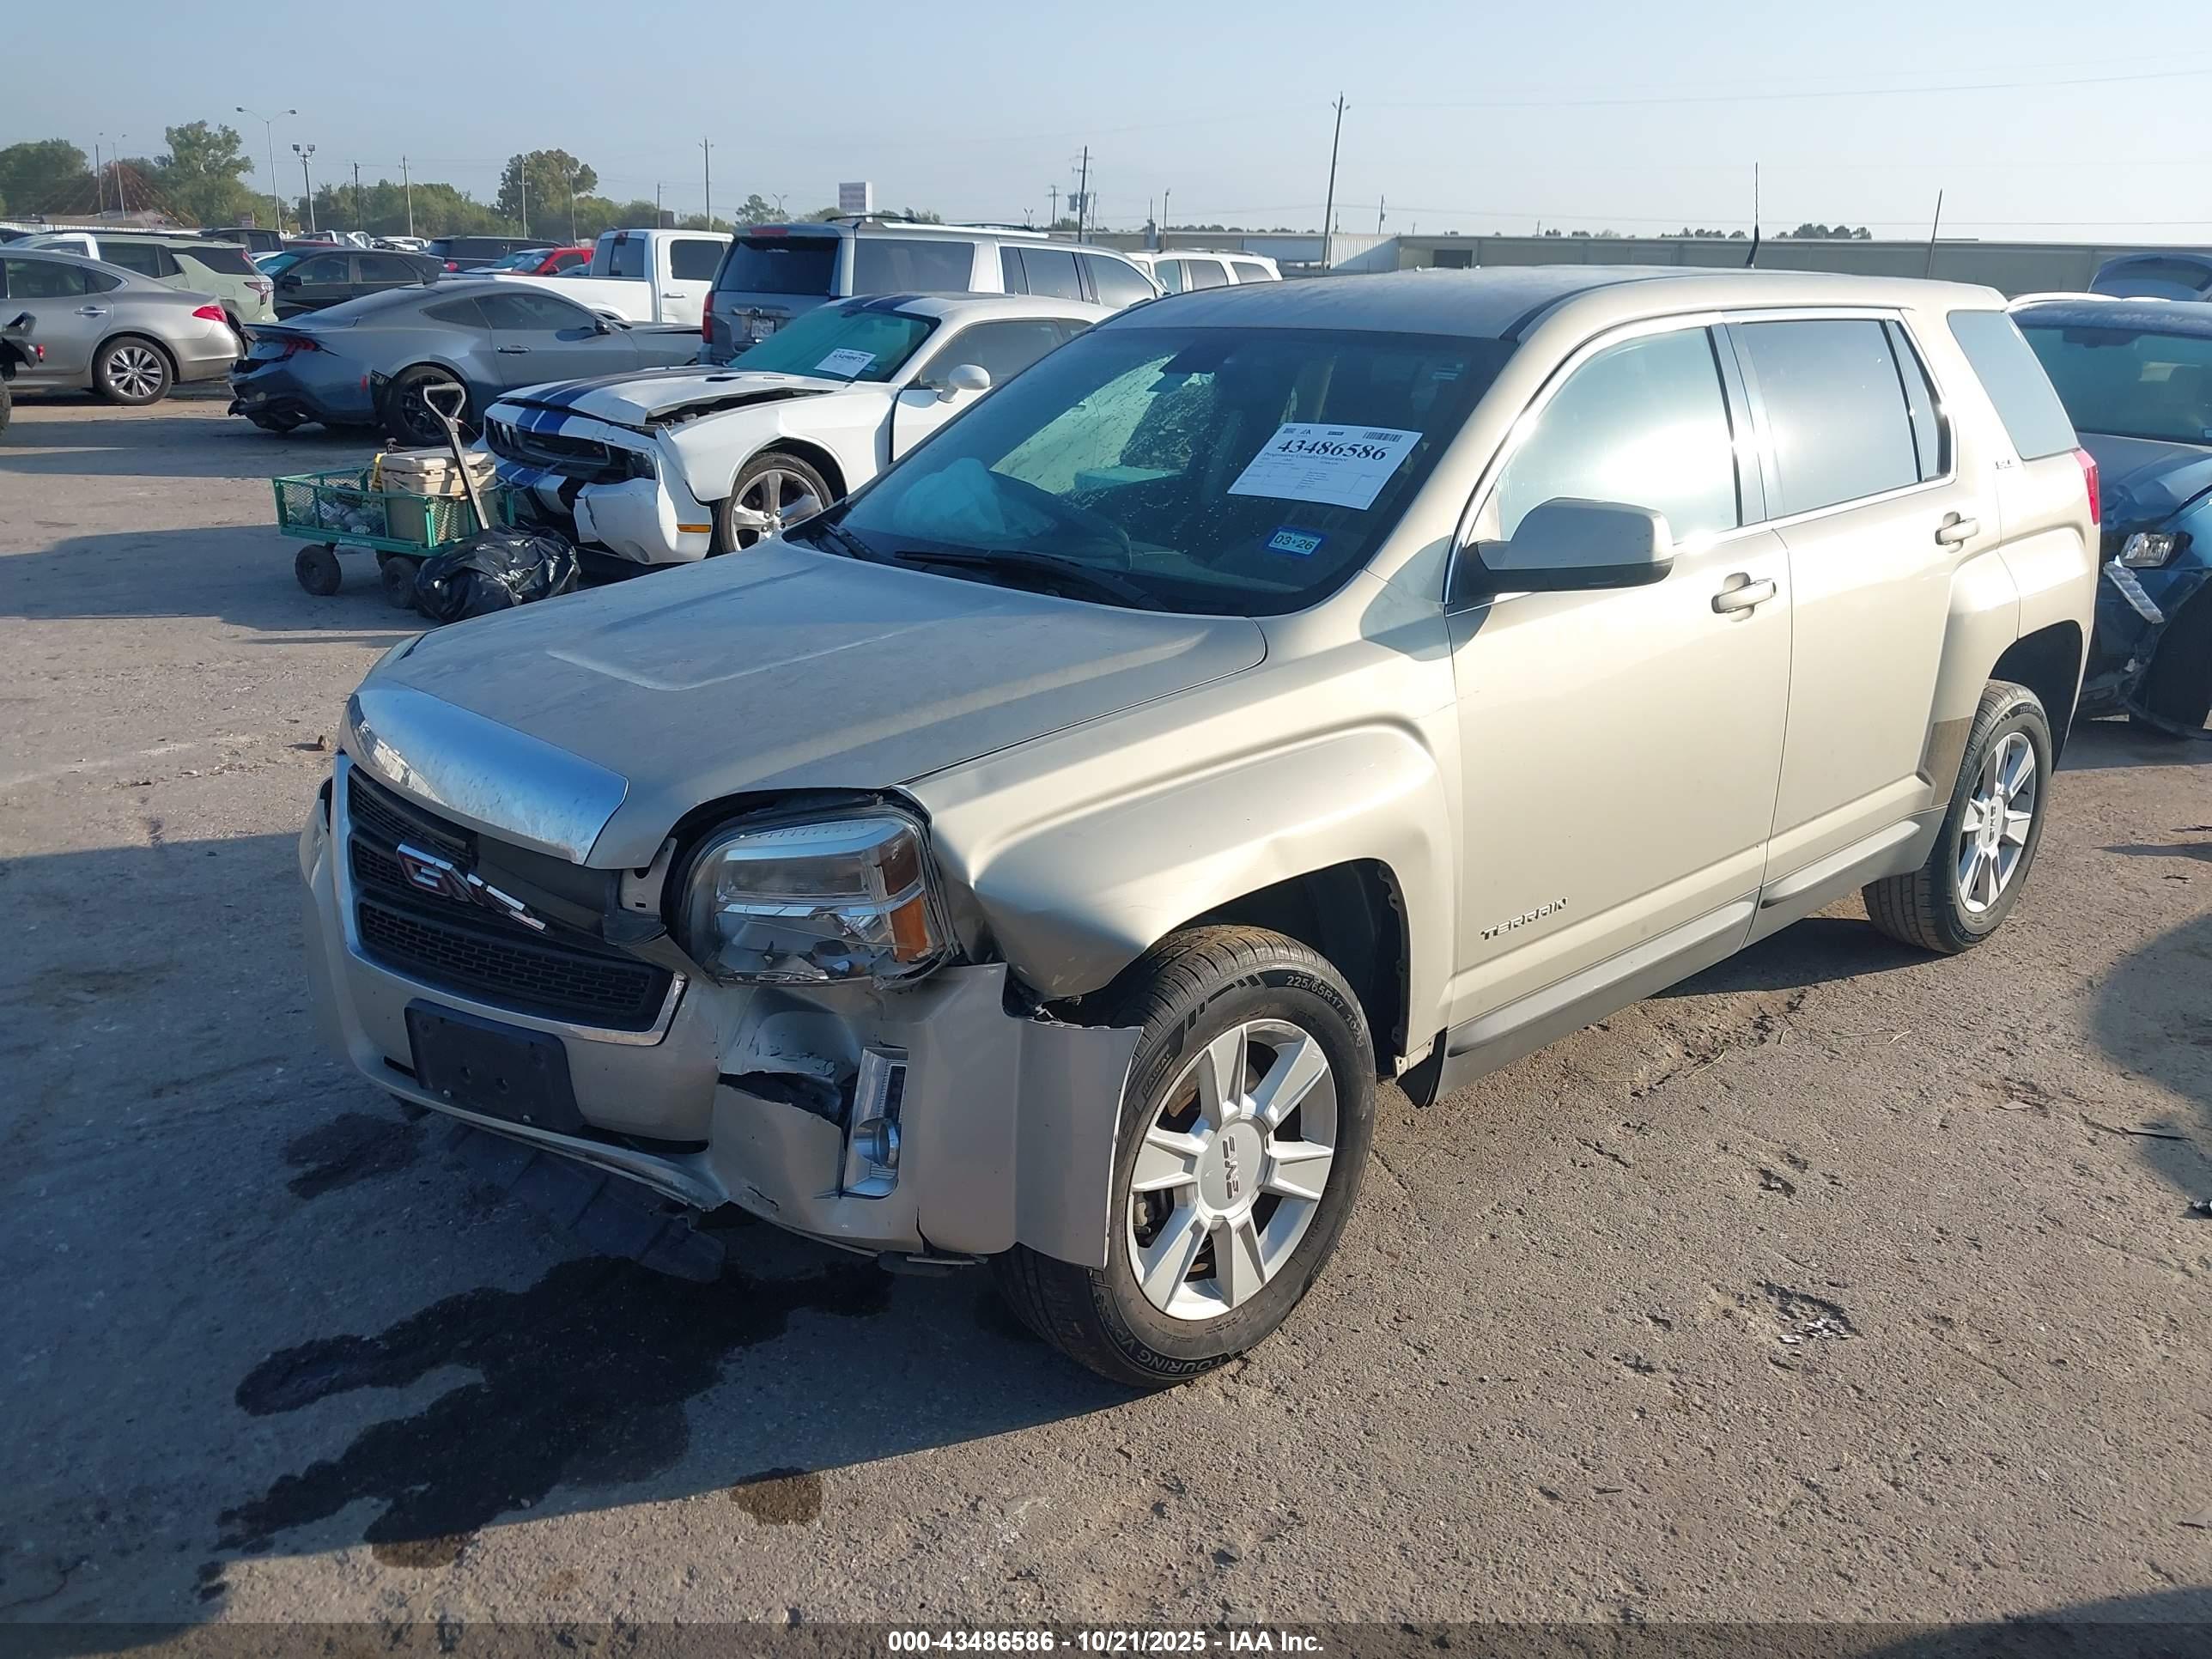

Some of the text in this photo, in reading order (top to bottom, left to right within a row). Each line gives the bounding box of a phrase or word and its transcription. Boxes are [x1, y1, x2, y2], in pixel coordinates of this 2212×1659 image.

[1277, 439, 1392, 461] 43486586
[1480, 896, 1568, 942] TERRAIN
[1285, 975, 1345, 1011] 225/65R17
[1137, 1349, 1225, 1374] TOURING
